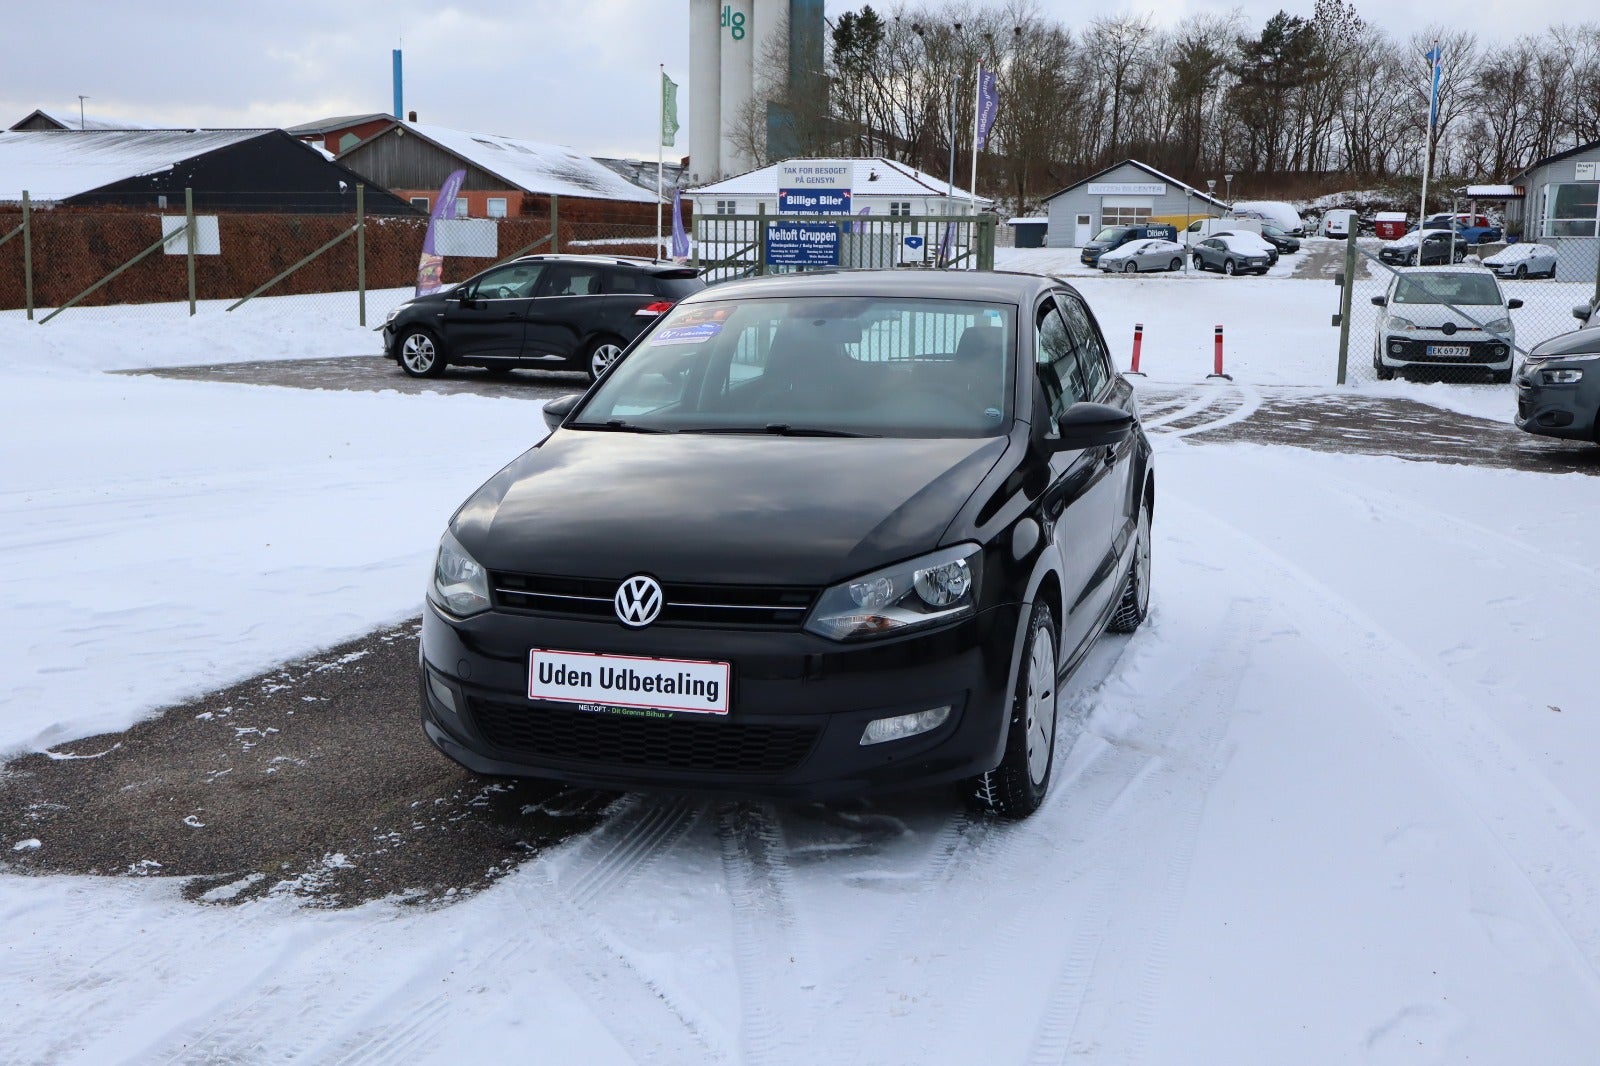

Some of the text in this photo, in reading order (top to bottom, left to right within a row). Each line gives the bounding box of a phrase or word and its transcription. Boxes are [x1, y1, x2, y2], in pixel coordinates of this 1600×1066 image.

[720, 5, 746, 41] dlg
[980, 101, 993, 133] Gruppen
[784, 167, 847, 175] TAK FOR BESØGET
[795, 176, 805, 184] PÅ
[786, 195, 843, 207] Billige Biler
[768, 228, 837, 244] Neltoft Gruppen
[1432, 347, 1469, 355] EK 69 727
[538, 661, 719, 702] Uden Udbetaling
[578, 704, 607, 713] NELTOFT
[622, 708, 645, 717] Grønne
[646, 710, 666, 718] Bilhus
